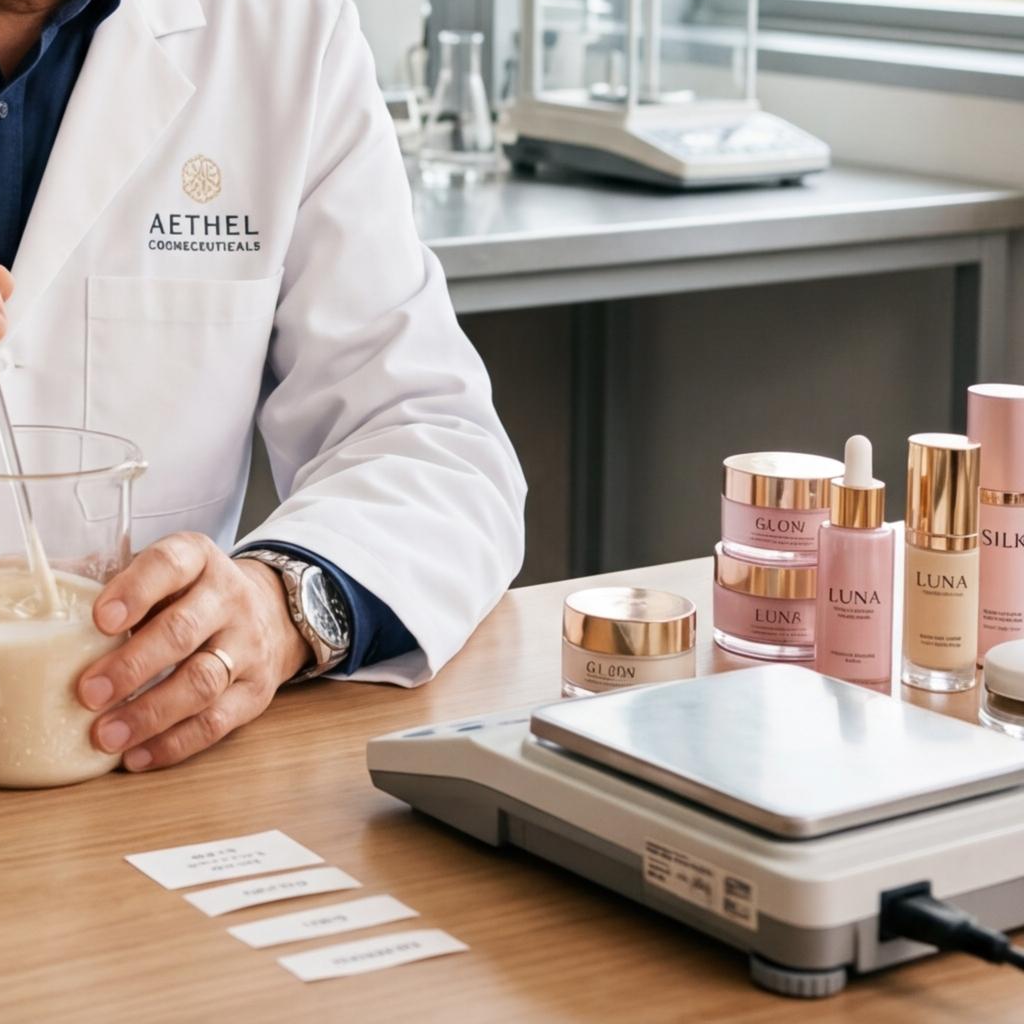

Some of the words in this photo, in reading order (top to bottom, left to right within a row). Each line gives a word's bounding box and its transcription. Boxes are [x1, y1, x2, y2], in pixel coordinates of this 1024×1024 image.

[149, 213, 259, 236] AETHEL
[982, 529, 1024, 549] SILK
[917, 571, 968, 589] LUNA
[829, 587, 881, 605] LUNA
